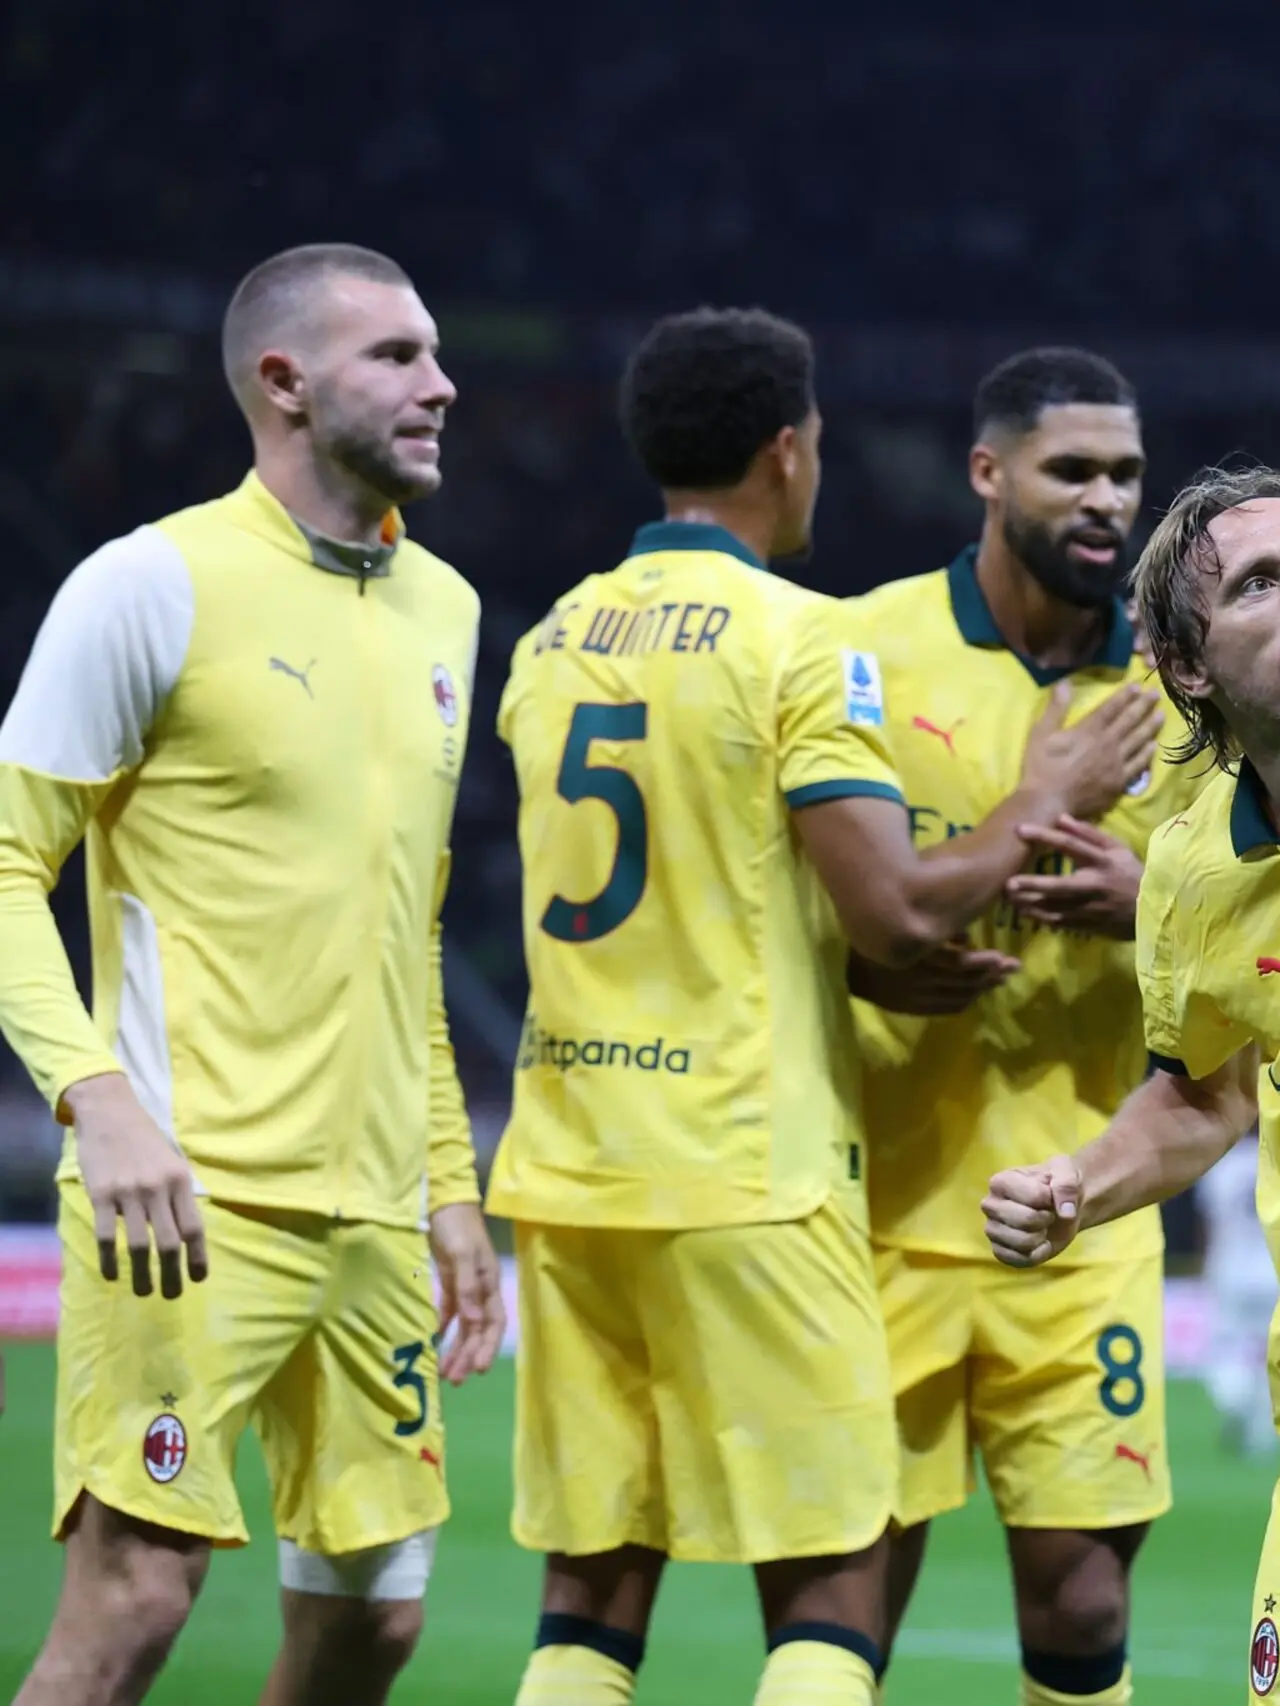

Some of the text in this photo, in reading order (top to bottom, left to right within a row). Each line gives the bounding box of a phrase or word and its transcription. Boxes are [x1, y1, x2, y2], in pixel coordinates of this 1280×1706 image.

[539, 701, 648, 943] 5
[393, 1332, 440, 1437] 3
[1097, 1323, 1145, 1417] 8
